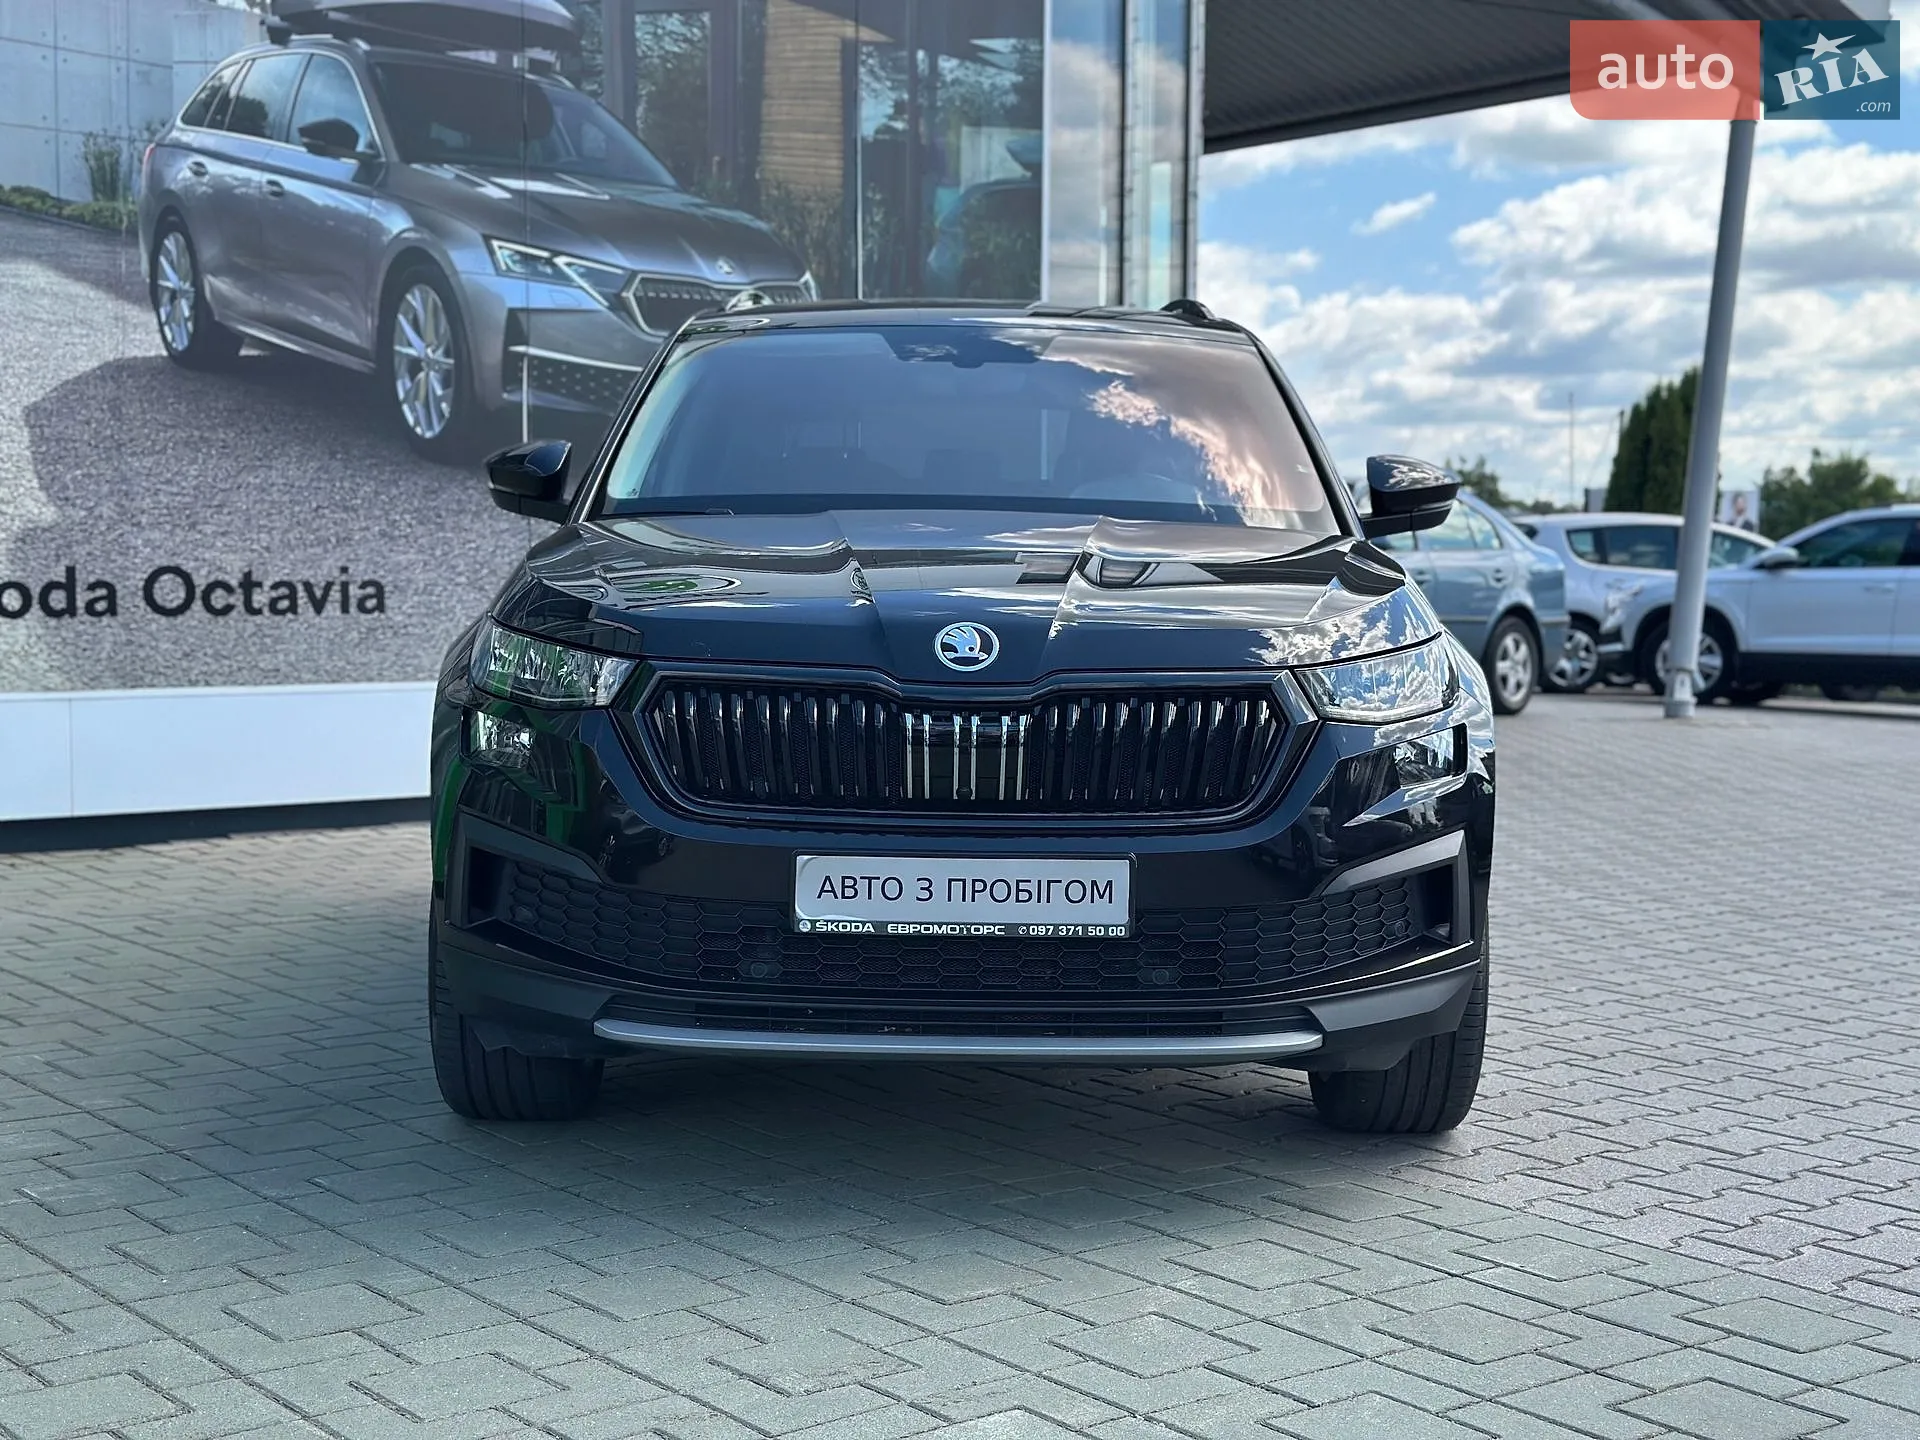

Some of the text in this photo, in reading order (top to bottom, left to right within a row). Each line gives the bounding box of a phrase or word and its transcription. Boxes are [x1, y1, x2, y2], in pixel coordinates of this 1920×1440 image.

[143, 565, 385, 617] Octavia
[816, 875, 1114, 904] АВТО З ПРОБІГОМ
[815, 919, 1126, 937] ŠKODA ЕВРОМОТОРС 097 371 50 00
